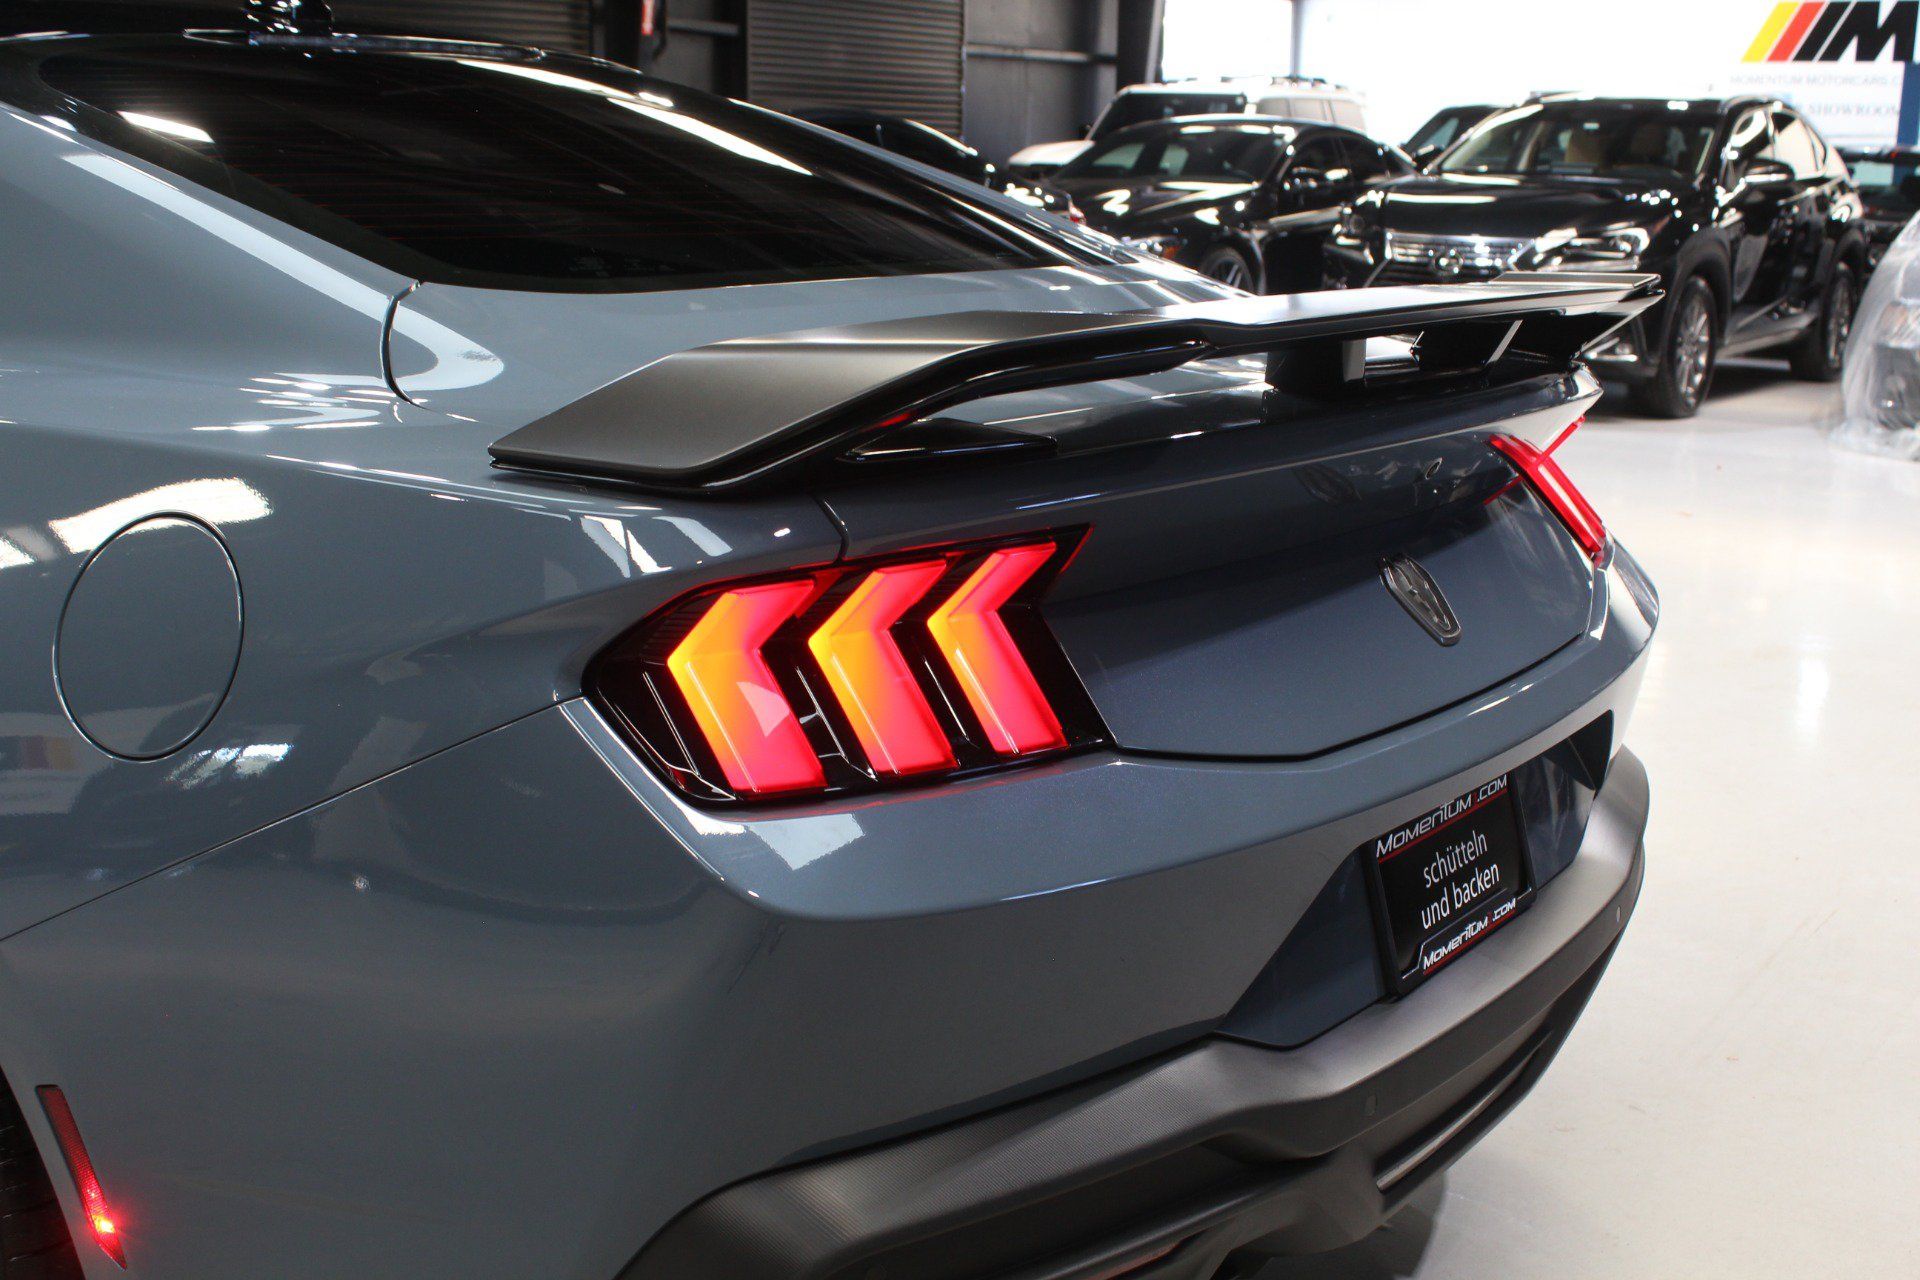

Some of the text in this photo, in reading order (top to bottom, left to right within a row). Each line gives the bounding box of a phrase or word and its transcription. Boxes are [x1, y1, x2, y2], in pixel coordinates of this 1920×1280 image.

[1423, 830, 1488, 888] schütteln
[1421, 863, 1500, 930] und backen
